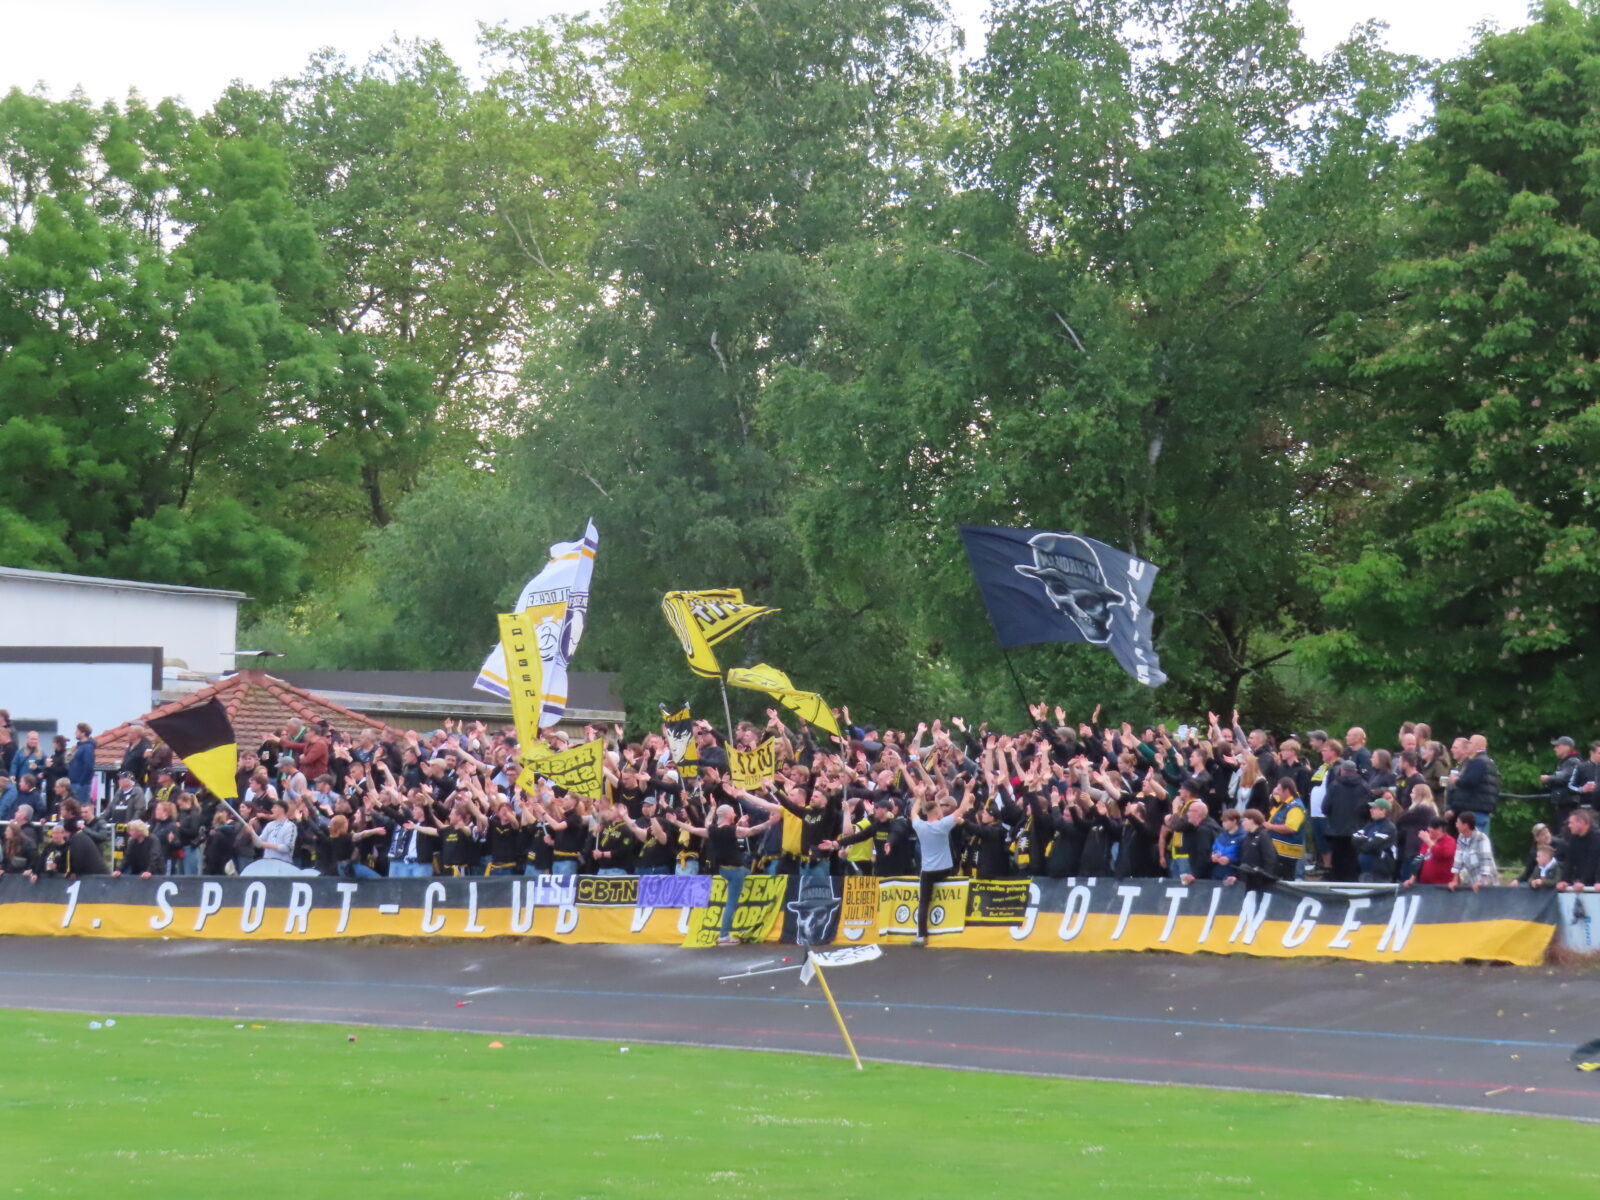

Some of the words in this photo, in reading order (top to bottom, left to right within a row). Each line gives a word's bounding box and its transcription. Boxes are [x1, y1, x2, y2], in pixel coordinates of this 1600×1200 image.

[61, 880, 101, 928] 1.
[1009, 876, 1421, 952] GÖTTINGEN
[881, 888, 919, 902] BANDA
[932, 888, 962, 901] AVAL
